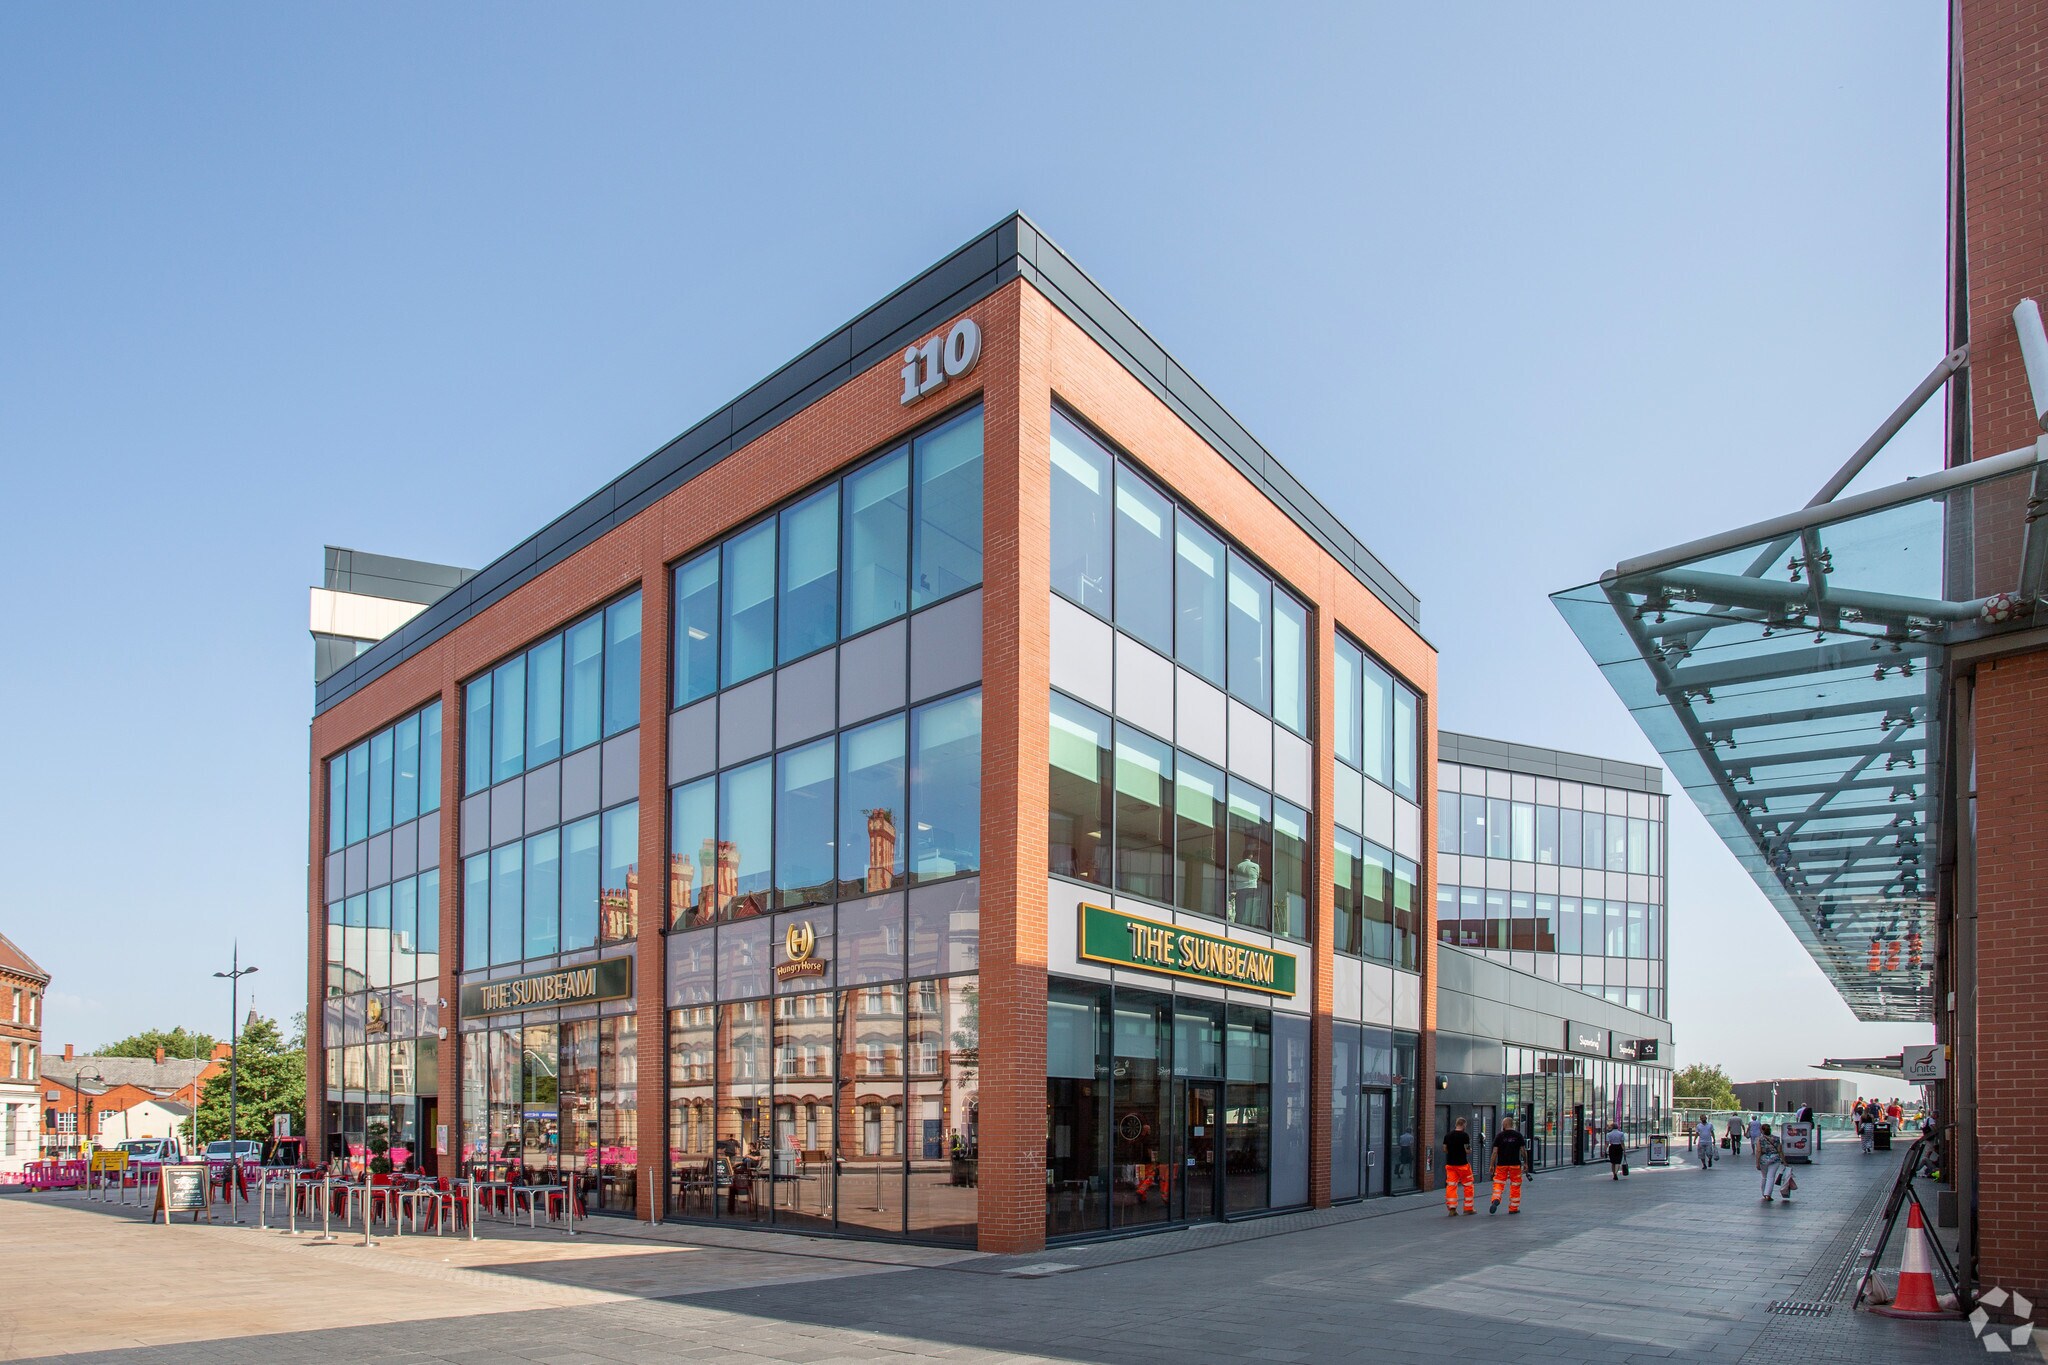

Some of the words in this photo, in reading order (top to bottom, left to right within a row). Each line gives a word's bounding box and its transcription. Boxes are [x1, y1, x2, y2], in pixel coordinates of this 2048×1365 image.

[900, 317, 981, 406] i10
[777, 963, 801, 976] Hungry
[801, 960, 822, 971] Horse
[1127, 922, 1175, 967] THE
[1178, 935, 1274, 985] SUNBEAM
[480, 983, 511, 1010] THE
[512, 967, 597, 1006] SUNBEAM
[1910, 1064, 1937, 1073] unite
